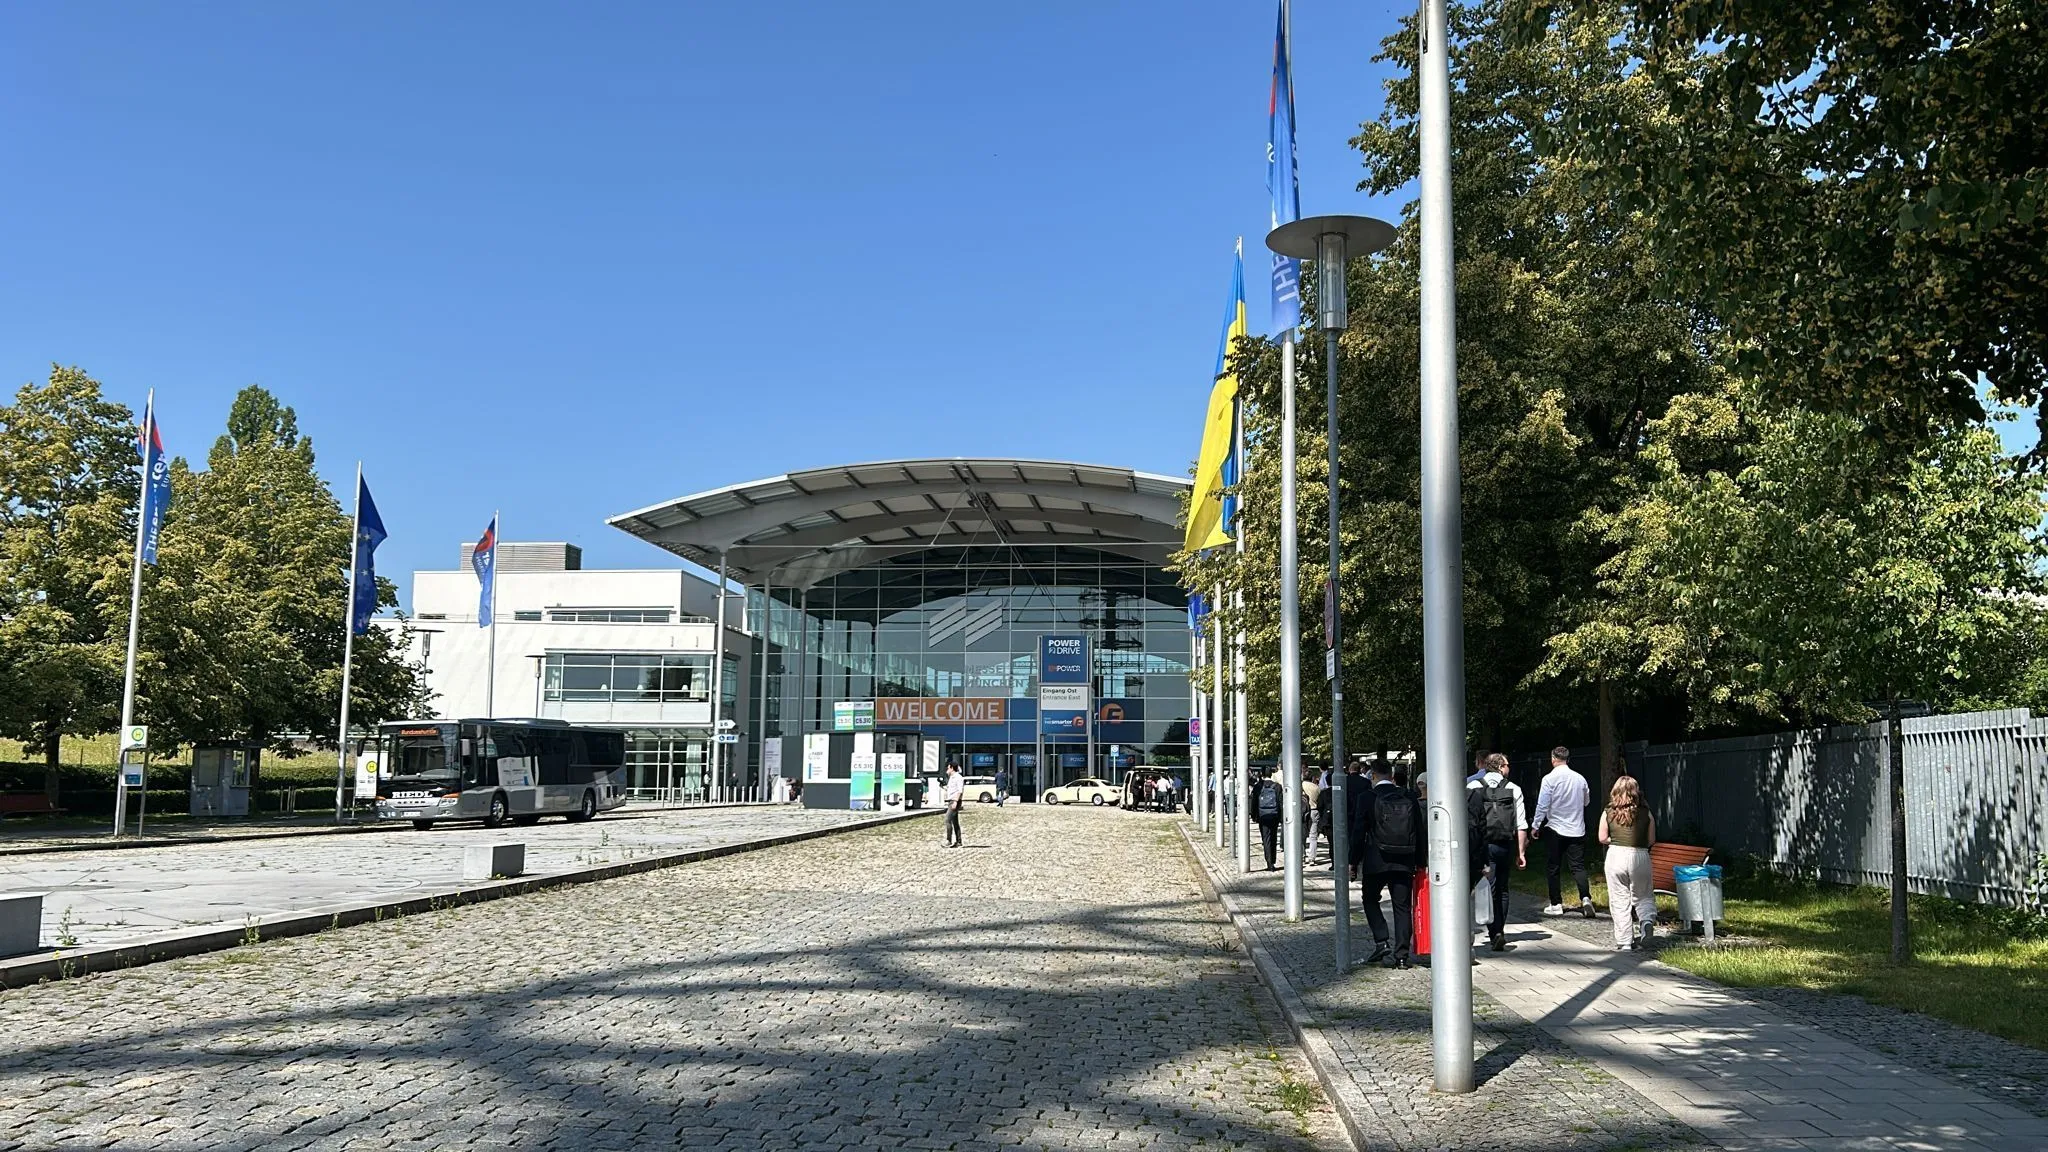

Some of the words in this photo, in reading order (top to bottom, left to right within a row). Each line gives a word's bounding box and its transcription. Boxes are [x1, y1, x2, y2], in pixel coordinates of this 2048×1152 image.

[1048, 639, 1081, 647] POWER
[884, 702, 1000, 720] WELCOME
[392, 790, 434, 799] RIEDL
